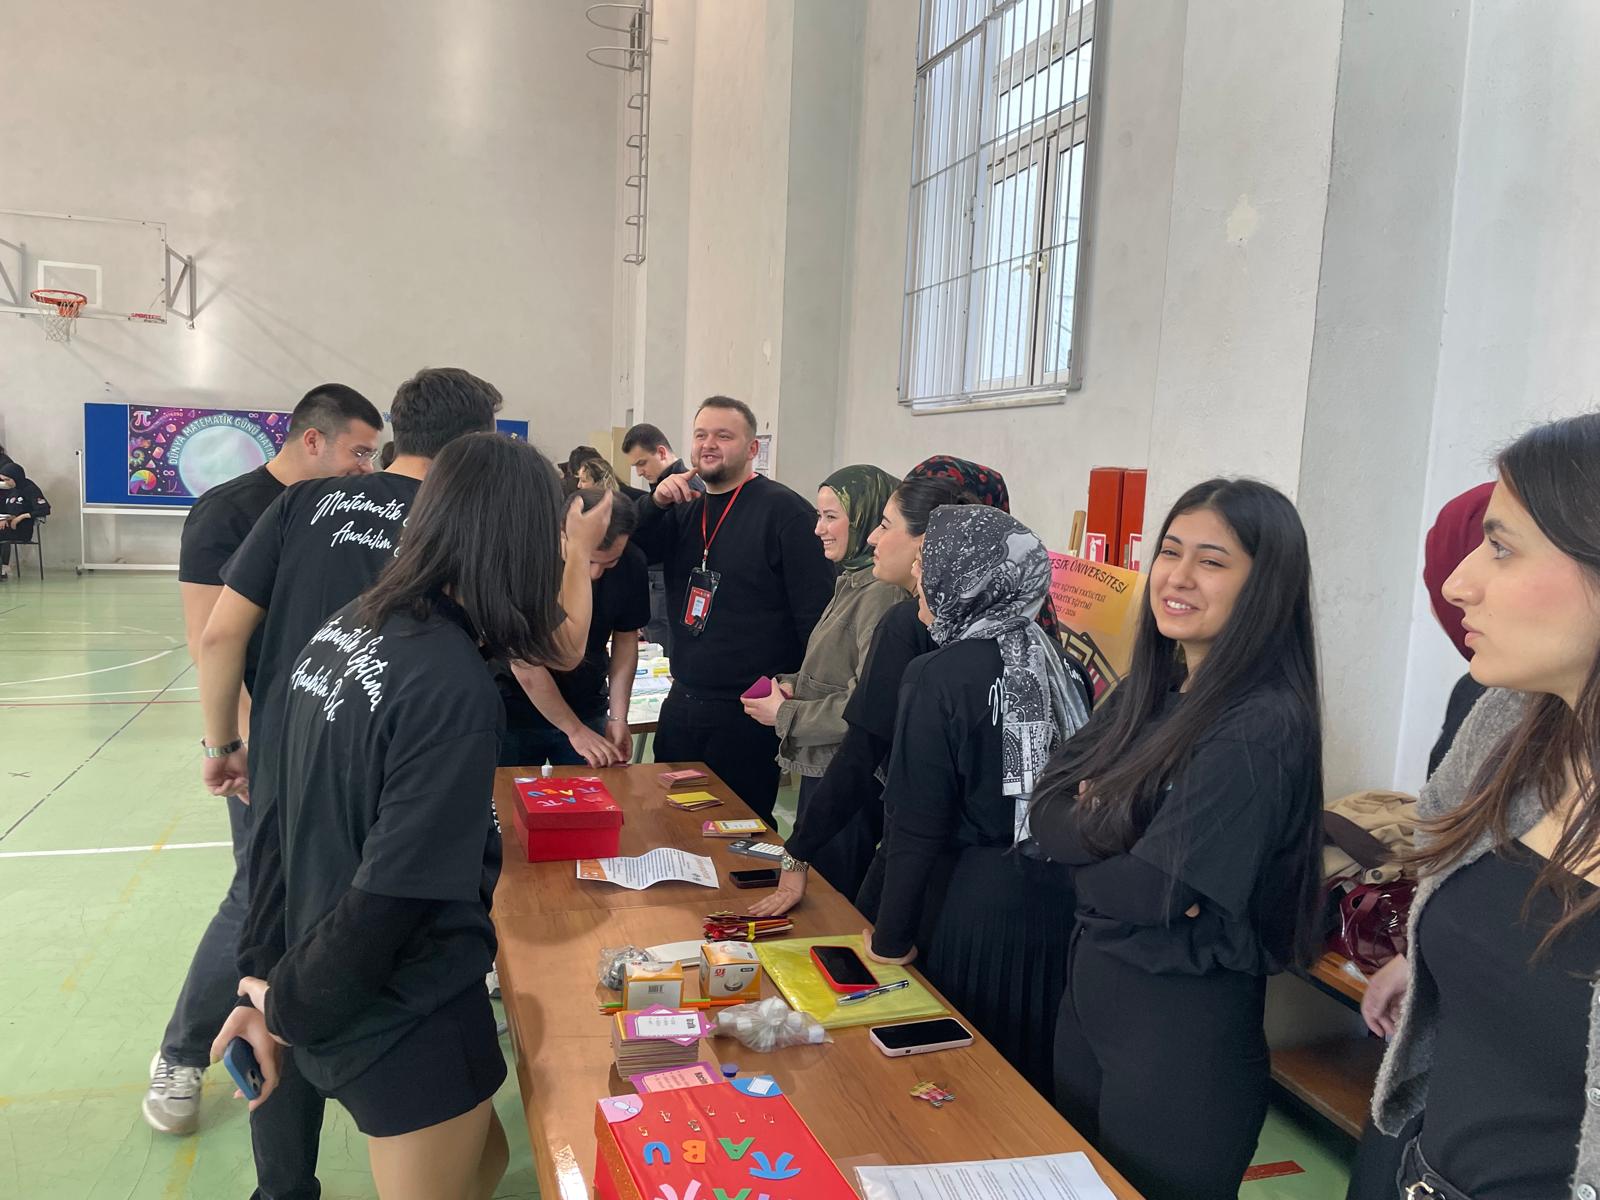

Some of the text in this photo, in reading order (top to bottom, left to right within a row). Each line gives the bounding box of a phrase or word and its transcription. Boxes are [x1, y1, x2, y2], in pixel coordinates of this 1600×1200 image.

[168, 413, 276, 465] DÜNYA MATEMATİK GÜNÜ HATIR
[310, 490, 405, 525] Matematik
[331, 520, 392, 548] Anabilim
[1070, 559, 1129, 594] ÜNİVERSİTESİ
[311, 616, 372, 652] tematik
